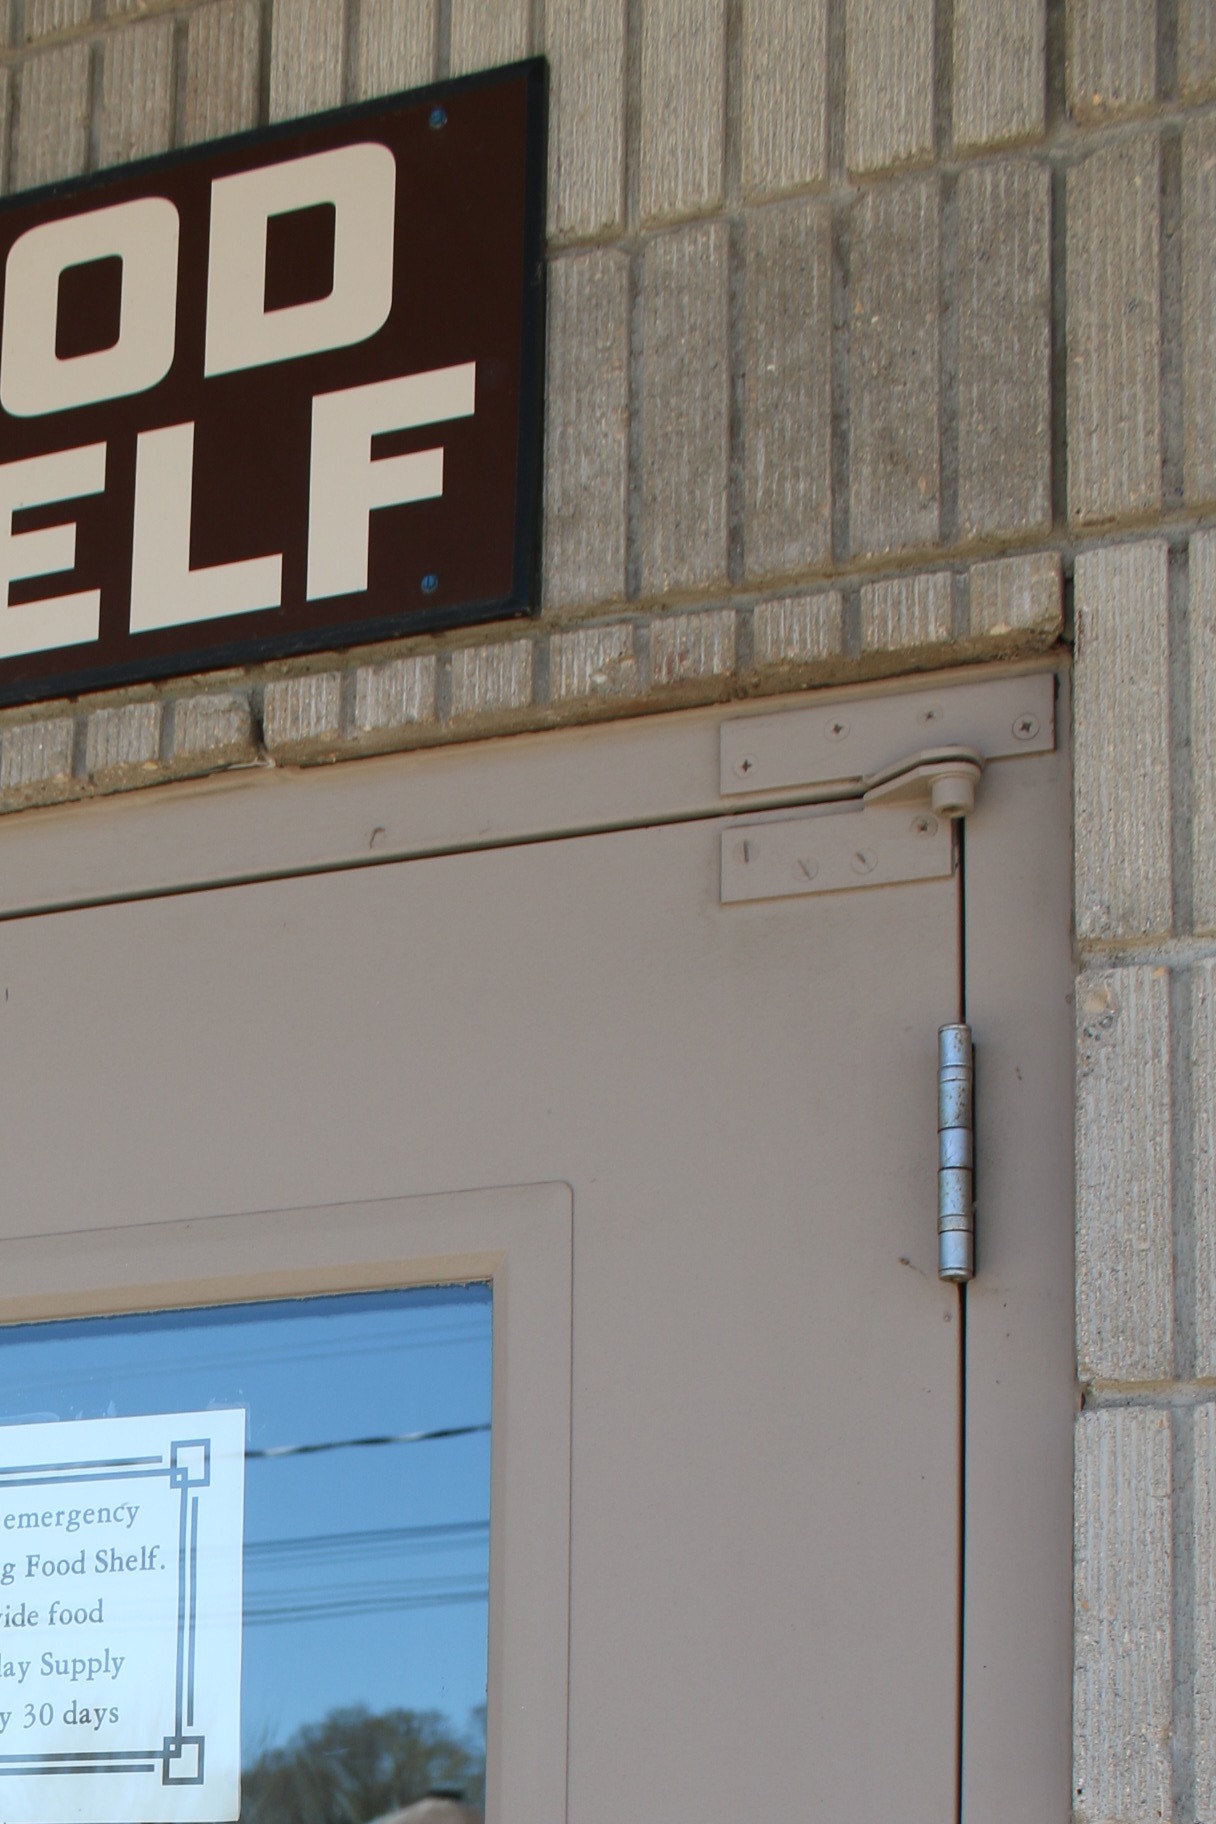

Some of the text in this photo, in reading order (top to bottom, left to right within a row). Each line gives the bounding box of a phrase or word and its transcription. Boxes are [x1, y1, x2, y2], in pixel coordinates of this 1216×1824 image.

[3, 1502, 141, 1534] emergency
[25, 1550, 86, 1579] Food
[94, 1545, 167, 1574] Shelf.
[48, 1599, 104, 1626] food
[39, 1648, 126, 1681] Supply
[22, 1702, 54, 1729] 30
[62, 1700, 120, 1731] days
